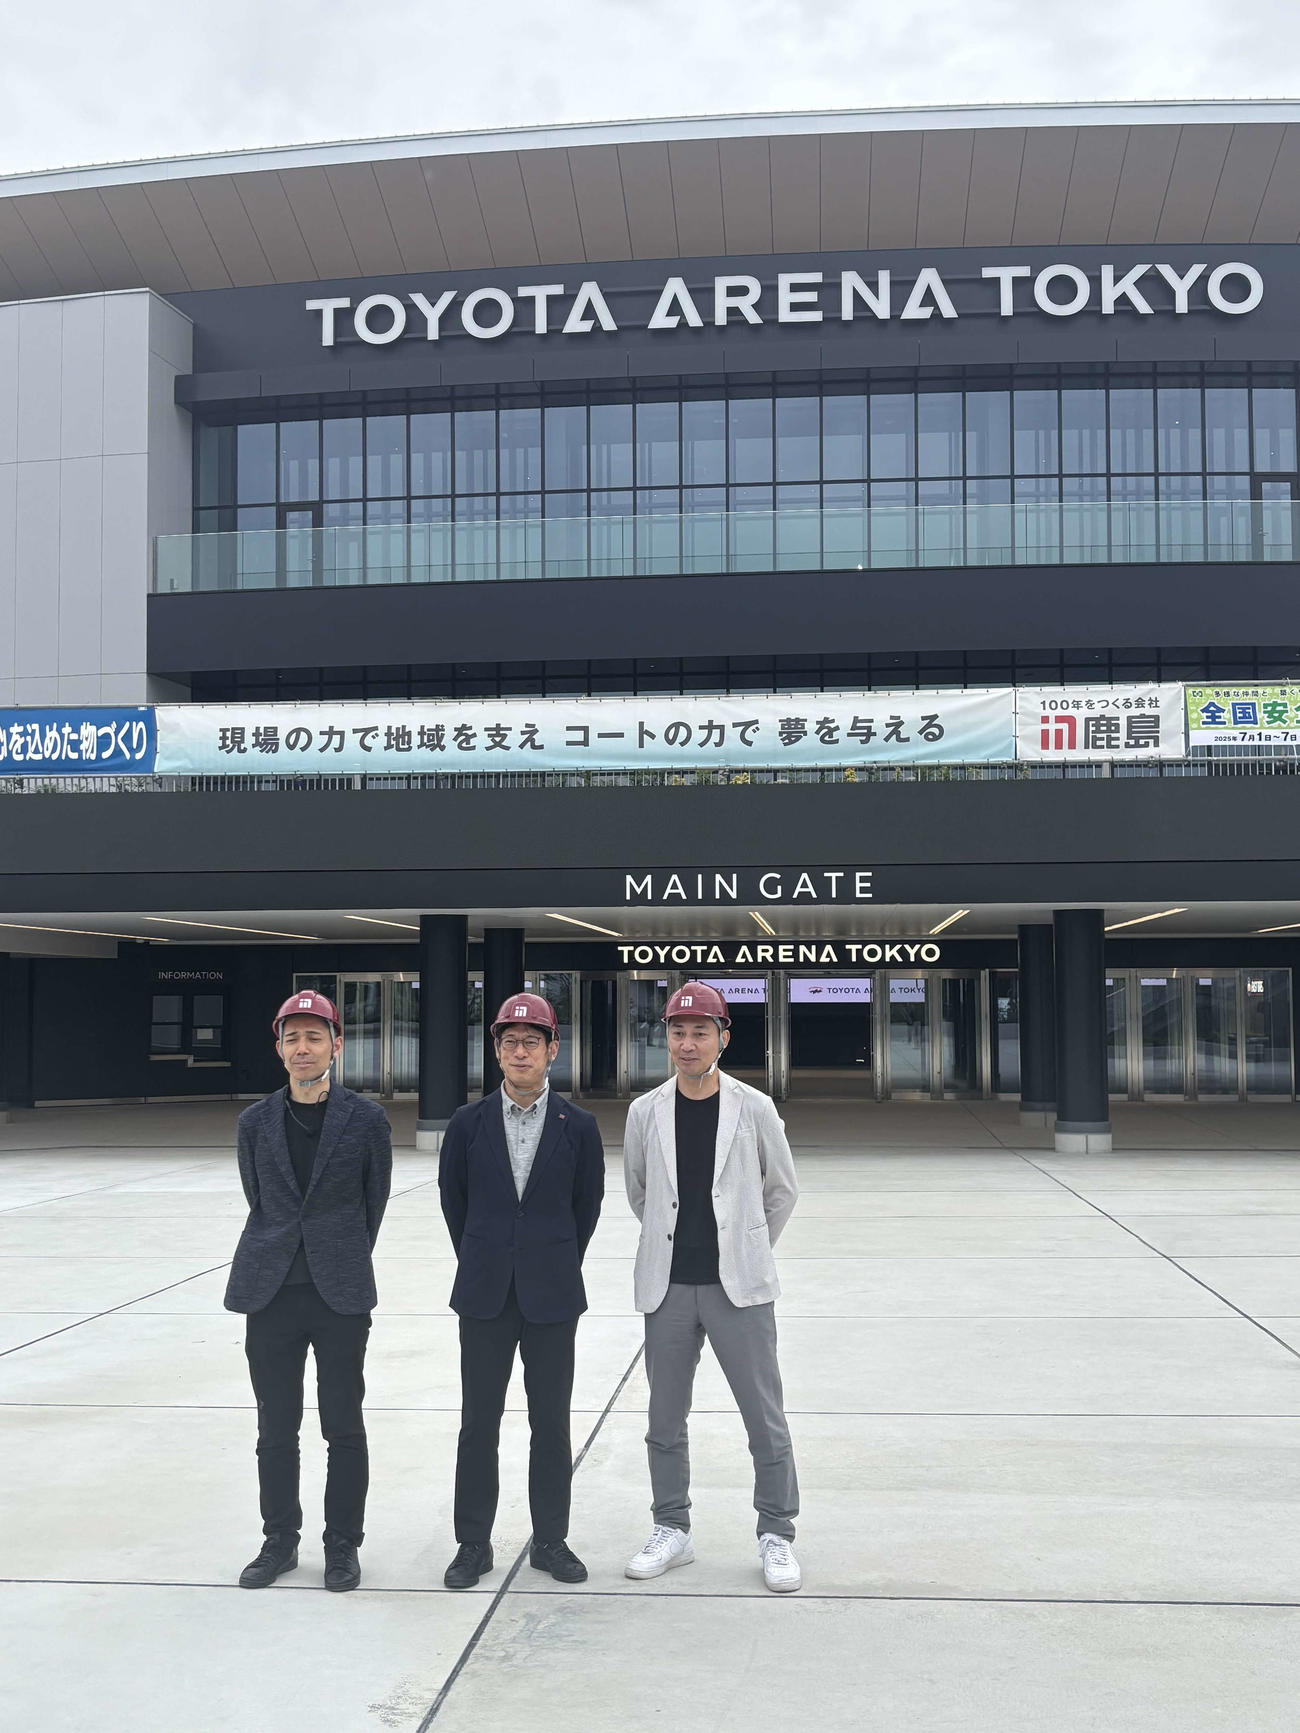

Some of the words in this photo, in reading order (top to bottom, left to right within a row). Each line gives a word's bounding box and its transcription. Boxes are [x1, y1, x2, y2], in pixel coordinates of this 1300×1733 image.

[305, 281, 618, 347] TOYOTA
[647, 267, 959, 330] ARENA
[981, 262, 1264, 317] TOKYO
[1040, 697, 1160, 711] 100年をつくる会社
[1200, 701, 1300, 726] 全国安
[218, 723, 545, 755] 現場の力で地域を支え
[565, 718, 760, 750] コートの力で
[778, 713, 946, 747] 夢を与える
[1084, 713, 1160, 750] 鹿島
[625, 873, 738, 900] MAIN
[759, 871, 874, 899] GATE
[618, 945, 725, 964] TOYOTA
[735, 944, 838, 963] ARENA
[846, 943, 941, 963] TOKYO
[158, 971, 223, 980] INFORMATION
